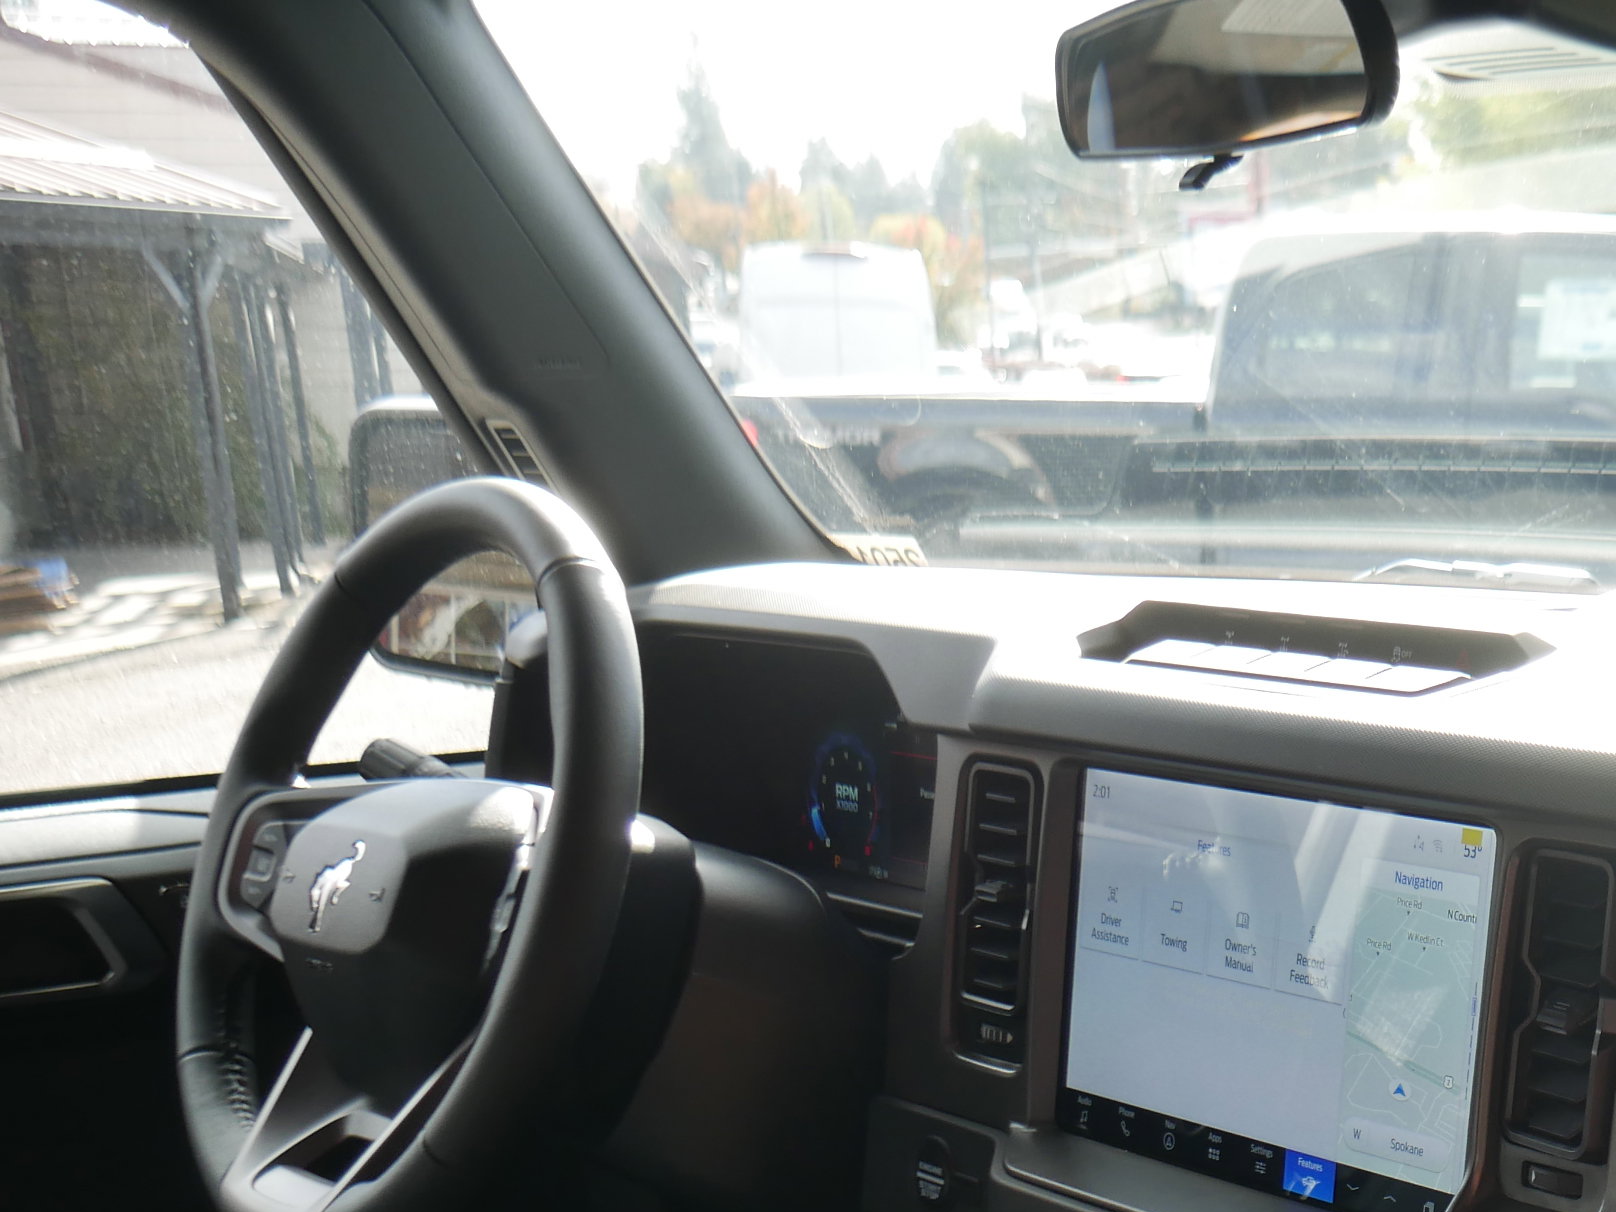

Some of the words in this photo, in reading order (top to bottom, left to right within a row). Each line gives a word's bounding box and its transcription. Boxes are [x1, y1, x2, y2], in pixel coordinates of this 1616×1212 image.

[835, 783, 859, 802] RPM
[1092, 784, 1111, 799] 2:01
[834, 854, 841, 868] P
[1395, 871, 1444, 892] Navigation
[1101, 912, 1122, 928] Driver
[1091, 927, 1129, 946] Assistance
[1160, 933, 1188, 953] Towing
[1224, 938, 1257, 957] Owner's
[1224, 955, 1254, 974] Manual
[1296, 952, 1326, 970] Record
[1289, 969, 1329, 989] Feedback
[1118, 1106, 1135, 1119] Phone
[1208, 1132, 1223, 1145] Apps
[1353, 1127, 1362, 1140] W
[1250, 1143, 1273, 1159] Settings
[1390, 1138, 1424, 1157] Spokane
[1297, 1157, 1323, 1172] Features
